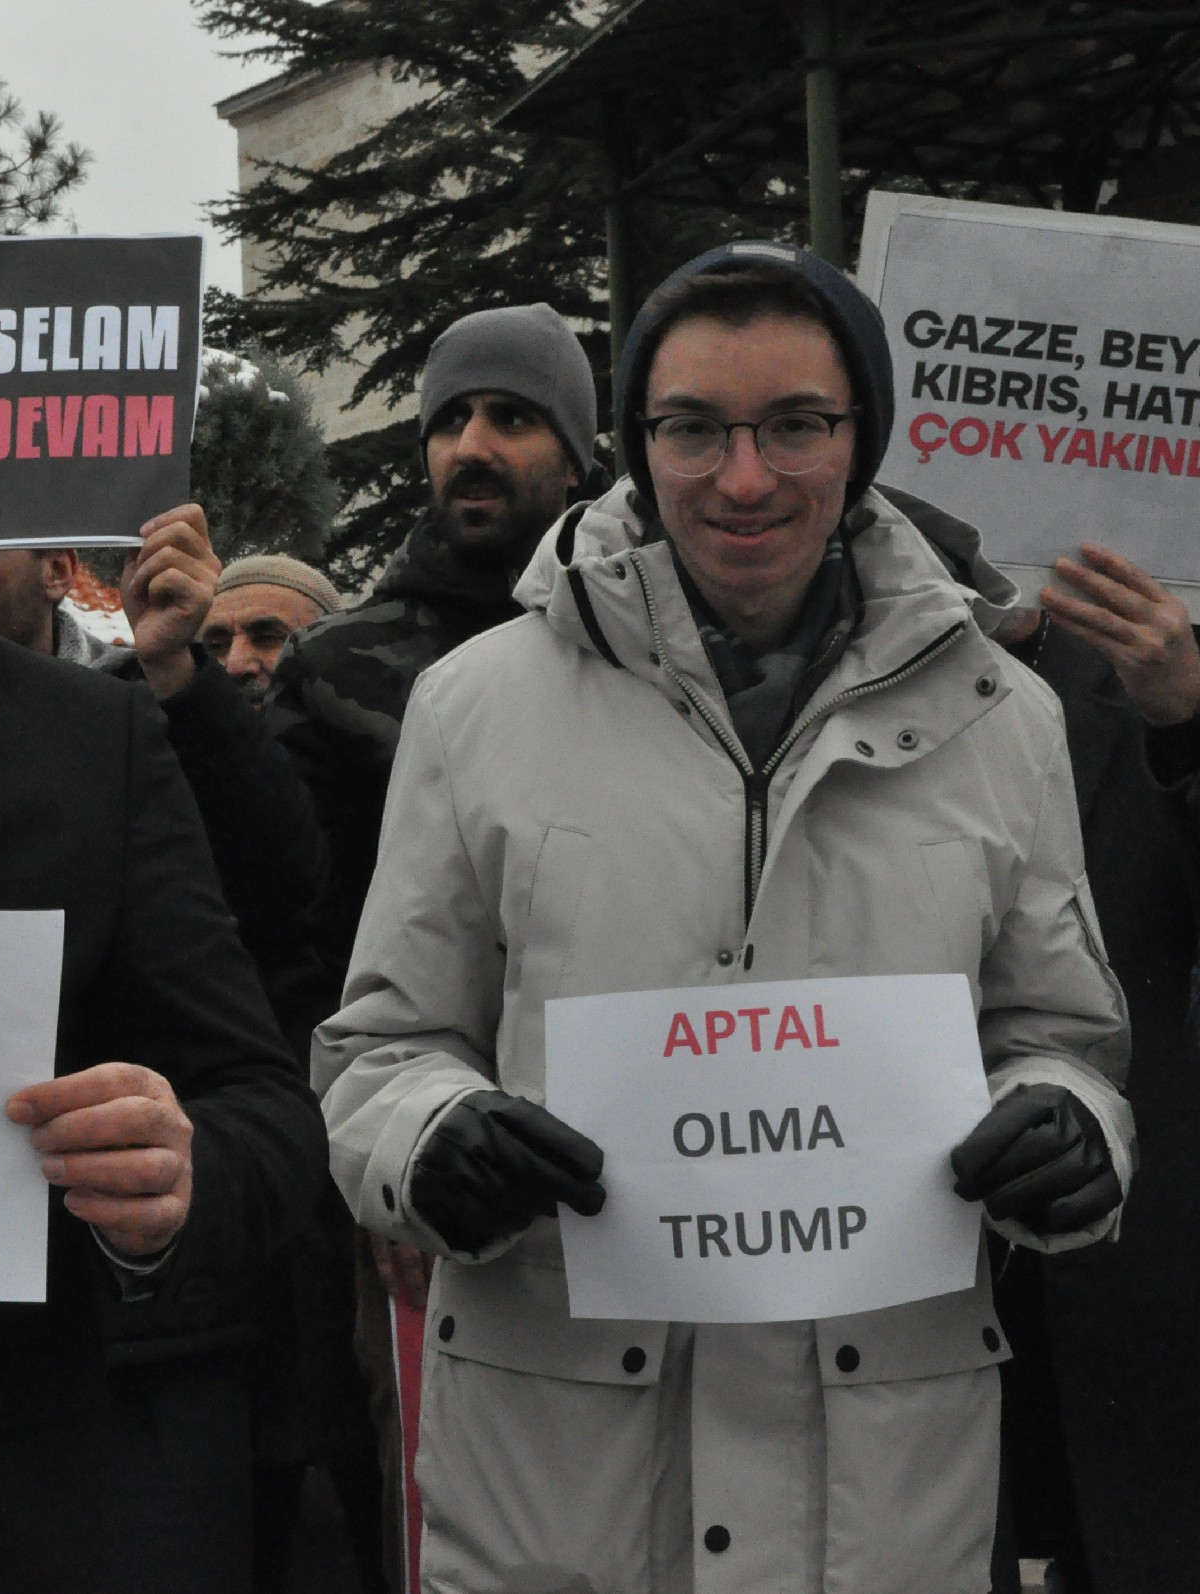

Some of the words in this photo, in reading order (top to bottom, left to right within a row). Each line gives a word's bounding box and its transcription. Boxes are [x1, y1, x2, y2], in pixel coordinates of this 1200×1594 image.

[903, 309, 1085, 370] GAZZE,
[1100, 329, 1200, 376] BEY
[911, 362, 1088, 421] KIBRIS,
[1103, 381, 1200, 426] HAT
[909, 412, 1027, 464] ÇOK
[663, 1004, 840, 1057] APTAL
[673, 1105, 845, 1157] OLMA
[659, 1205, 867, 1258] TRUMP
